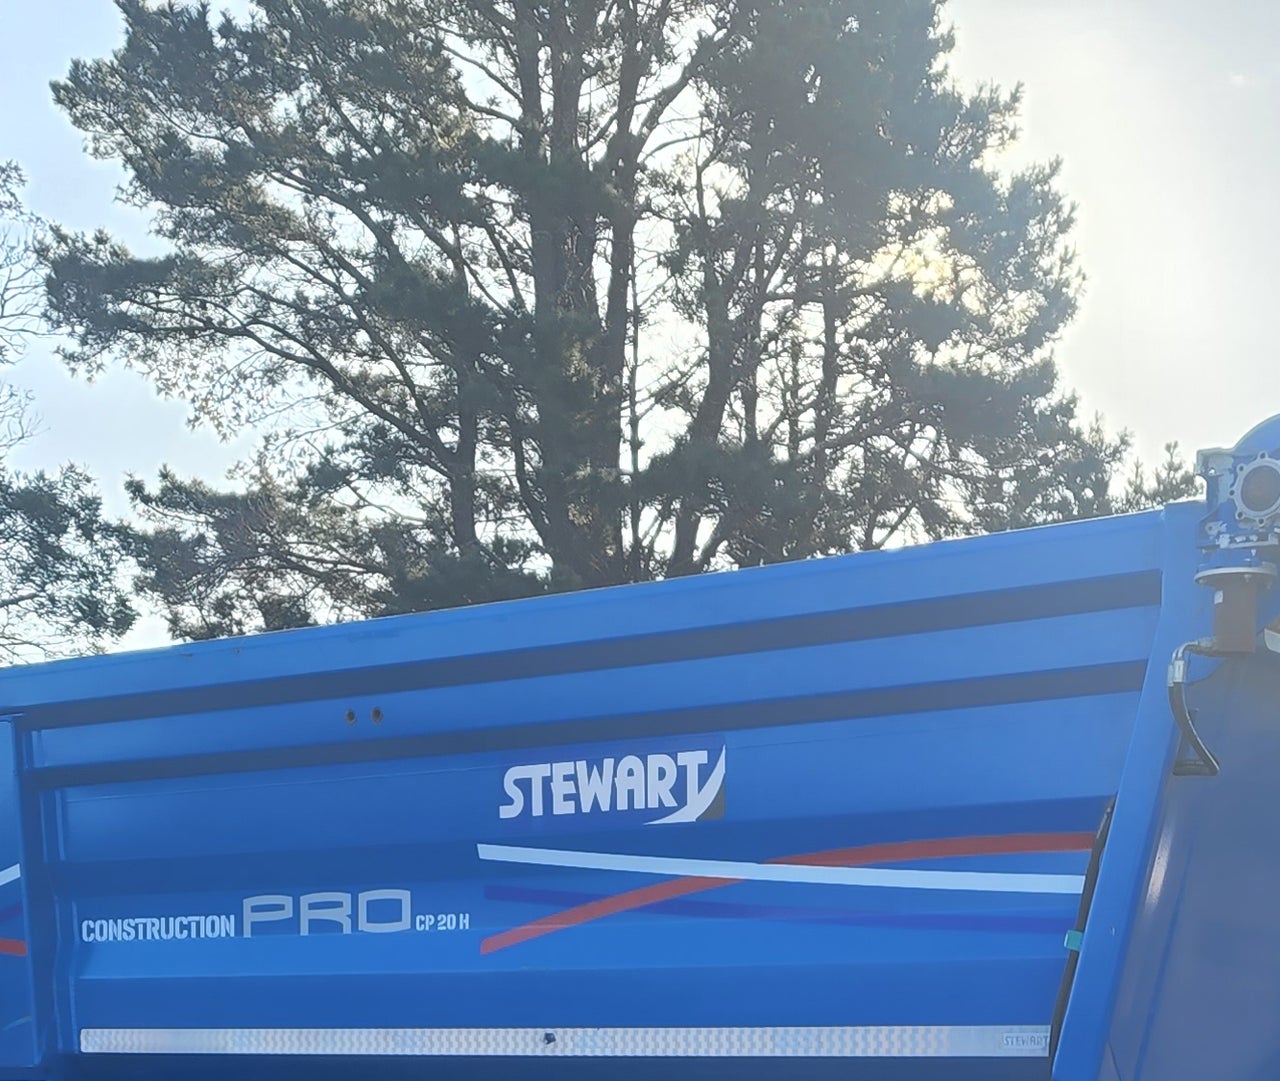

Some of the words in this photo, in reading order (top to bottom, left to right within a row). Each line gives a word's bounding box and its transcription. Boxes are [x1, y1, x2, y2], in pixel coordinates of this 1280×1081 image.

[499, 745, 726, 825] STEWART
[82, 914, 235, 942] CONSTRUCTION
[243, 889, 411, 938] PRO
[415, 914, 435, 931] CP
[437, 914, 457, 931] 20
[459, 913, 470, 930] H
